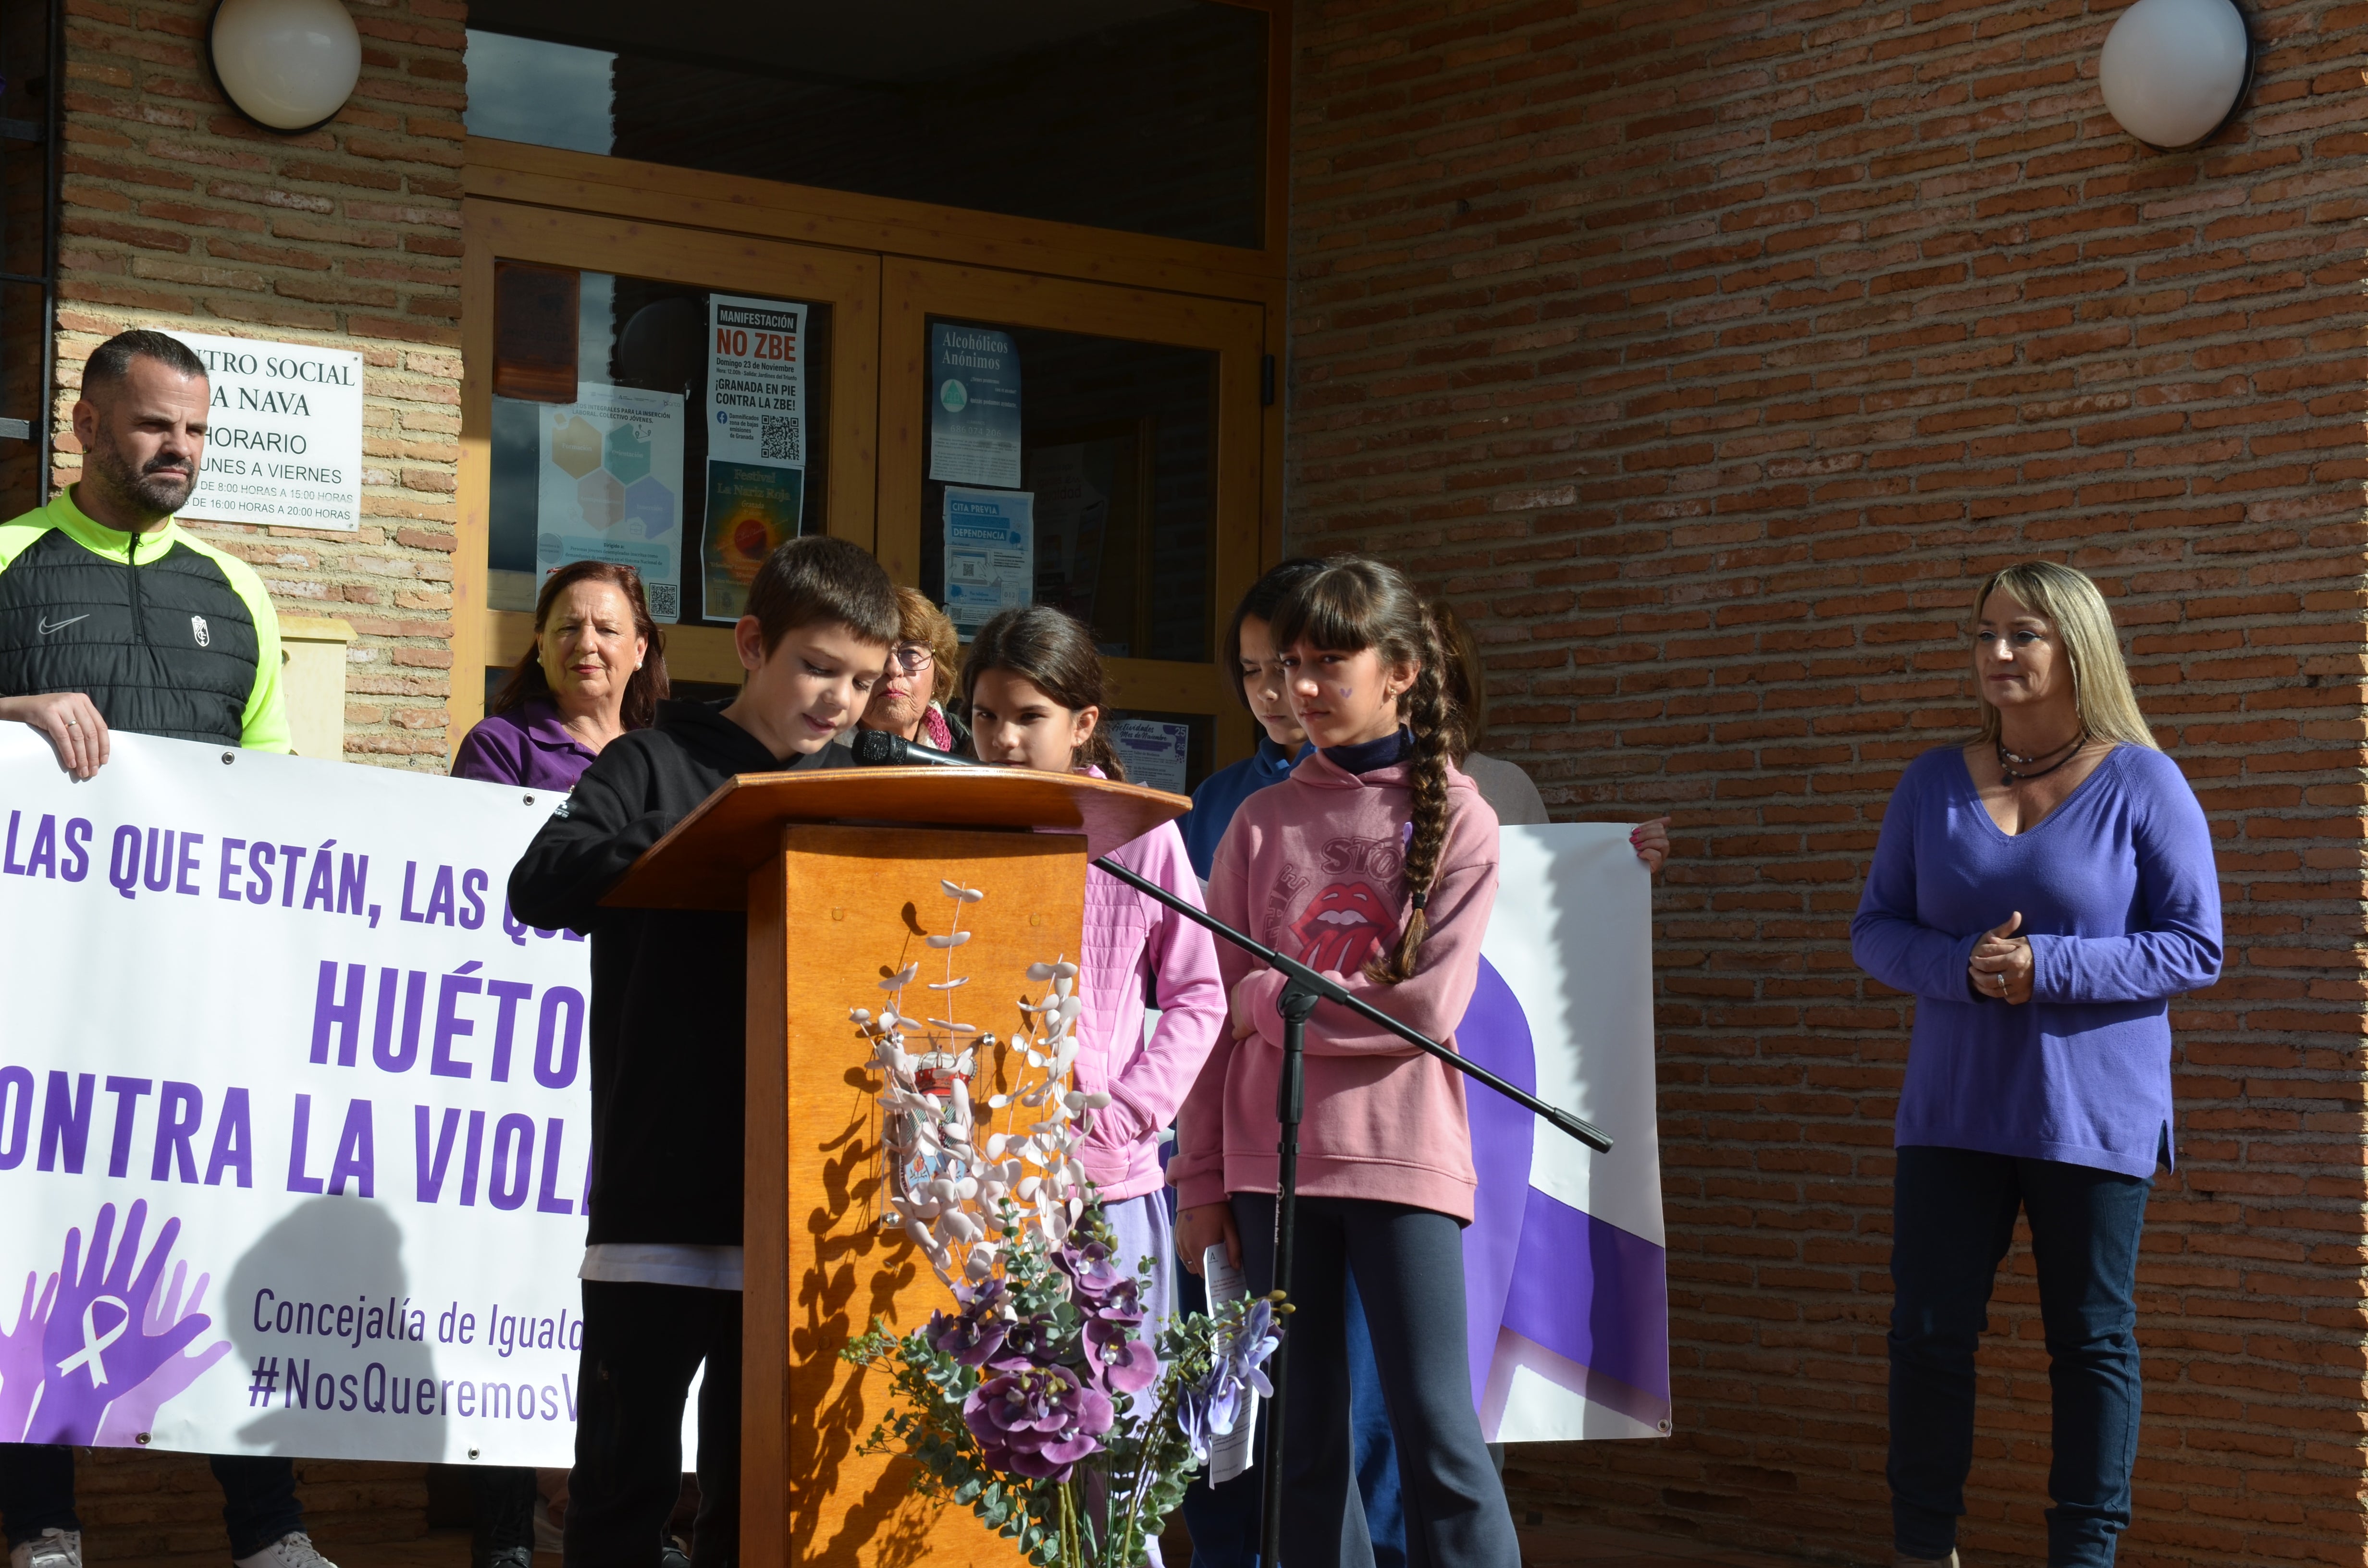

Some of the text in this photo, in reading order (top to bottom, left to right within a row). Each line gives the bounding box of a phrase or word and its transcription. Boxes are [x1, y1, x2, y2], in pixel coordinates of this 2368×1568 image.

[720, 310, 794, 329] MANIFESTACIÓN
[716, 328, 796, 362] NO ZBE
[943, 331, 1008, 354] Alcohólicos
[195, 349, 356, 387] TRO SOCIAL
[716, 357, 742, 368] Domingo
[762, 363, 794, 372] Noviembre
[942, 349, 1000, 370] Anónimos
[715, 379, 796, 396] ¡GRANADA EN PIE
[210, 385, 311, 417] A NAVA
[716, 392, 795, 411] CONTRA LA ZBE!
[588, 404, 620, 413] INTEGRALES
[642, 410, 671, 419] INSERCIÓN
[629, 415, 654, 423] JÓVENES.
[204, 426, 307, 454] HORARIO
[968, 427, 983, 435] 074
[986, 429, 1001, 437] 206
[562, 442, 592, 452] Formación
[200, 457, 342, 484] UNES A VIERNES
[734, 469, 776, 483] Festival
[201, 481, 353, 504] DE 8:00 HORAS A 15:00 HORAS
[716, 483, 792, 502] La Nariz Roja
[193, 498, 207, 507] DE
[210, 500, 236, 510] 16:00
[238, 502, 275, 514] HORAS
[277, 504, 285, 514] A
[287, 506, 313, 517] 20:00
[315, 508, 351, 521] HORAS
[741, 500, 765, 509] Granada
[952, 503, 998, 514] CITA PREVIA
[954, 528, 1005, 540] DEPENDENCIA
[1112, 723, 1154, 733] Actividades
[1142, 732, 1167, 741] Noviembre
[1175, 727, 1185, 737] 25
[1321, 836, 1405, 883] STO
[3, 810, 93, 882] LAS
[109, 824, 204, 900] QUE
[218, 838, 382, 929] ESTÁN,
[399, 860, 489, 931] LAS
[309, 960, 592, 1091] HUÉTO
[0, 1066, 592, 1217] ONTRA LA VIOL
[253, 1288, 584, 1358] Concejalía de Iguald
